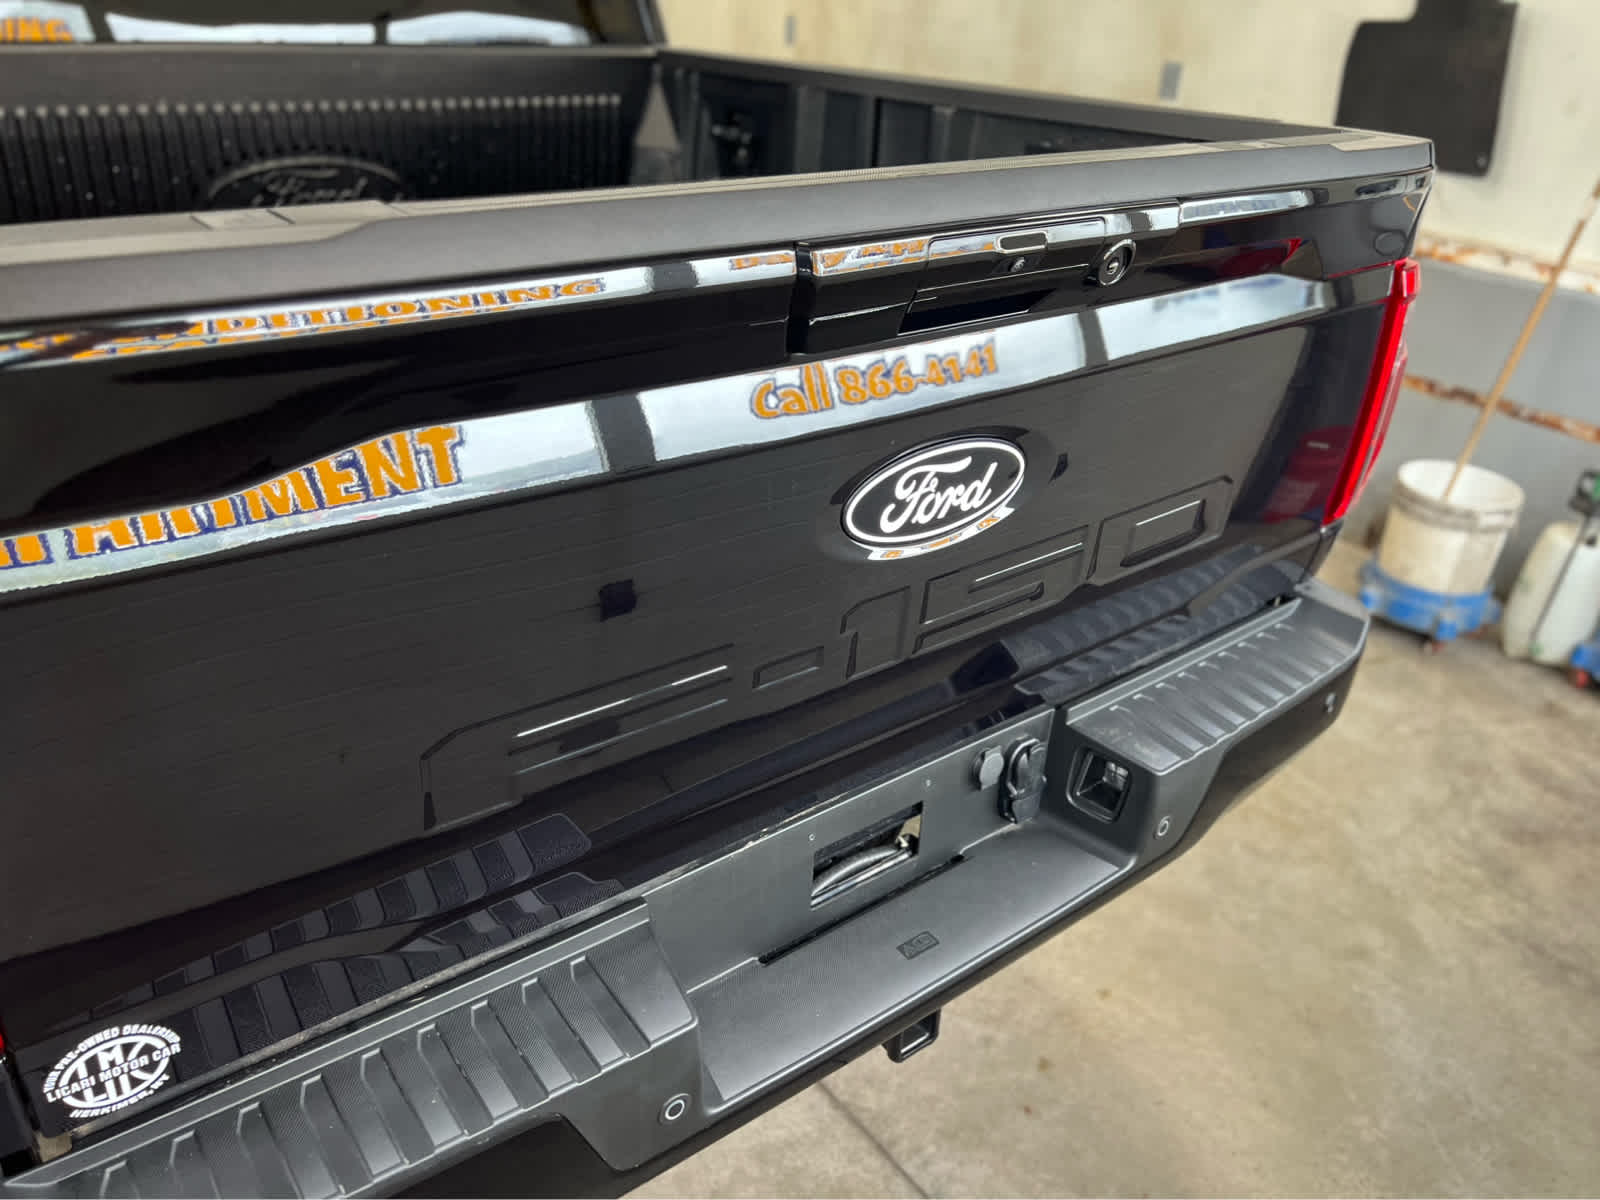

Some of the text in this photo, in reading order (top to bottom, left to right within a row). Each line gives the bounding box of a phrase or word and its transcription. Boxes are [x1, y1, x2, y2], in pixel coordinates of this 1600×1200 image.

[752, 340, 998, 419] Call 866-4141
[879, 456, 998, 533] Ford
[46, 1042, 181, 1103] LICARI MOTOR CAR
